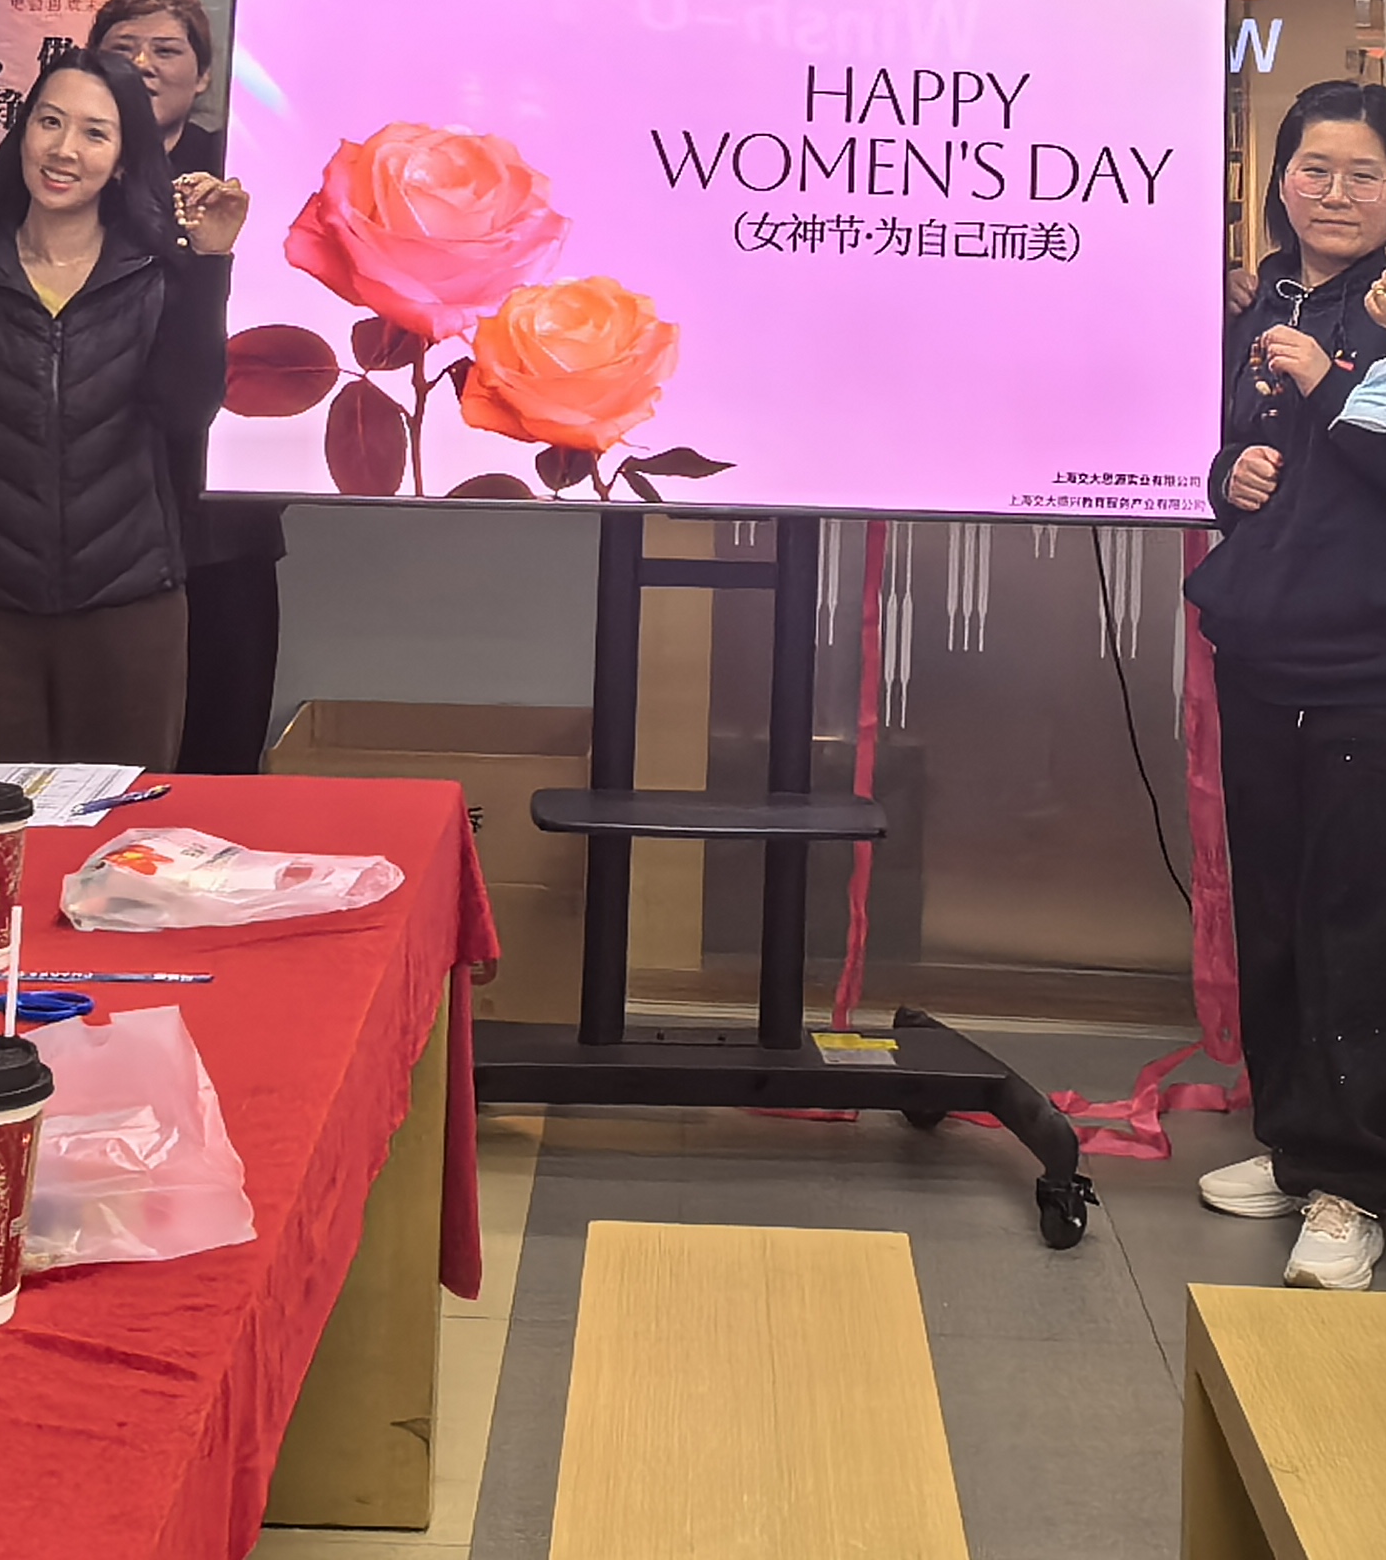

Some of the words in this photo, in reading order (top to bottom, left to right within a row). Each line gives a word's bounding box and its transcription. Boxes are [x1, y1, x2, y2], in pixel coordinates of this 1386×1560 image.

[806, 64, 1031, 129] HAPPY
[650, 129, 1007, 201] WOMEN'S
[1029, 143, 1176, 205] DAY
